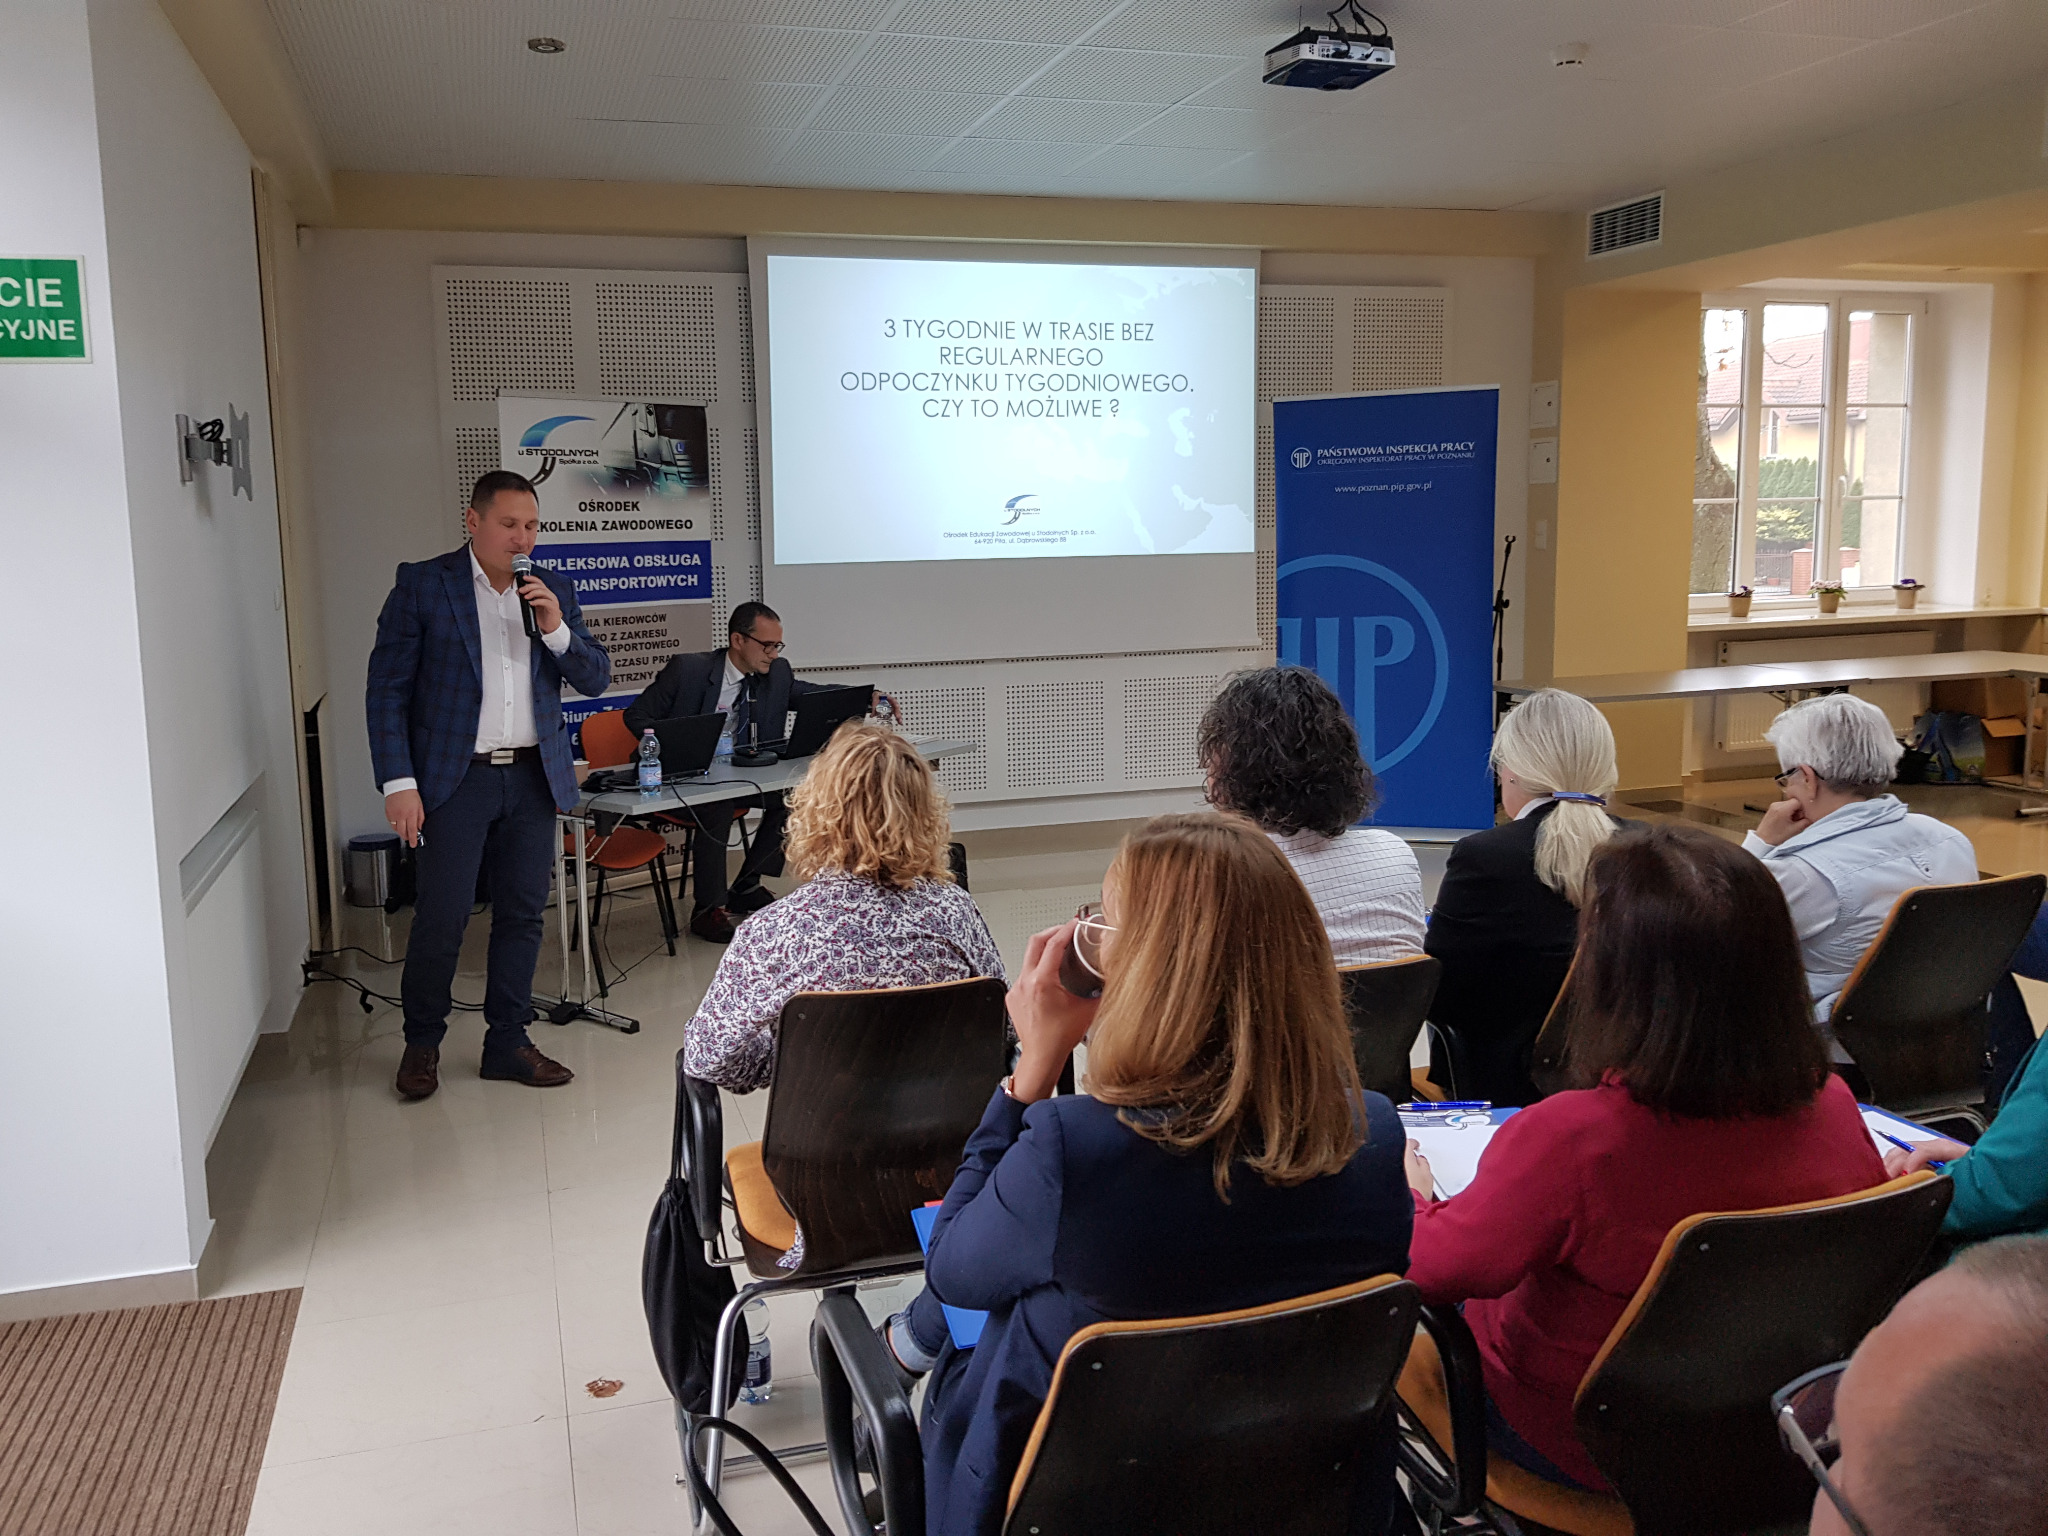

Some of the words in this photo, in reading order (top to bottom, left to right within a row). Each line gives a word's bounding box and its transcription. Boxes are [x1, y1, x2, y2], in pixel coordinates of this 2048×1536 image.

[0, 319, 76, 340] YJNE
[884, 318, 896, 338] 3
[903, 319, 1016, 339] TYGODNIE
[1023, 321, 1042, 339] W
[1049, 321, 1114, 341] TRASIE
[1122, 322, 1154, 341] BEZ
[940, 346, 1103, 366] REGULARNEGO
[841, 371, 997, 392] ODPOCZYNKU
[1005, 373, 1194, 393] TYGODNIOWEGO.
[923, 399, 964, 418] CZY
[971, 399, 998, 418] TO
[1006, 395, 1102, 418] MOŻLIWE
[1109, 398, 1120, 418] ?
[525, 448, 599, 457] STODOLNYCH
[1317, 445, 1384, 458] PAŃSTWOWA
[1386, 443, 1438, 455] INSPEKCJA
[1440, 441, 1475, 452] PRACY
[1317, 458, 1357, 466] OKRĘGOWY
[1358, 455, 1402, 464] INSPEKTORAT
[1404, 454, 1426, 462] PRACY
[1437, 451, 1476, 460] POZNANIU
[1334, 480, 1432, 495] www.poznan.pip.gov.pl
[578, 499, 640, 512] OŚRODEK
[536, 521, 598, 532] KOLENIA
[601, 519, 694, 531] ZAWODOWEGO
[633, 554, 701, 567] OBSŁUGA
[604, 613, 667, 626] KIEROWCÓW
[611, 633, 617, 641] Z
[621, 629, 667, 640] ZAKRESU
[615, 657, 648, 668] CZASU
